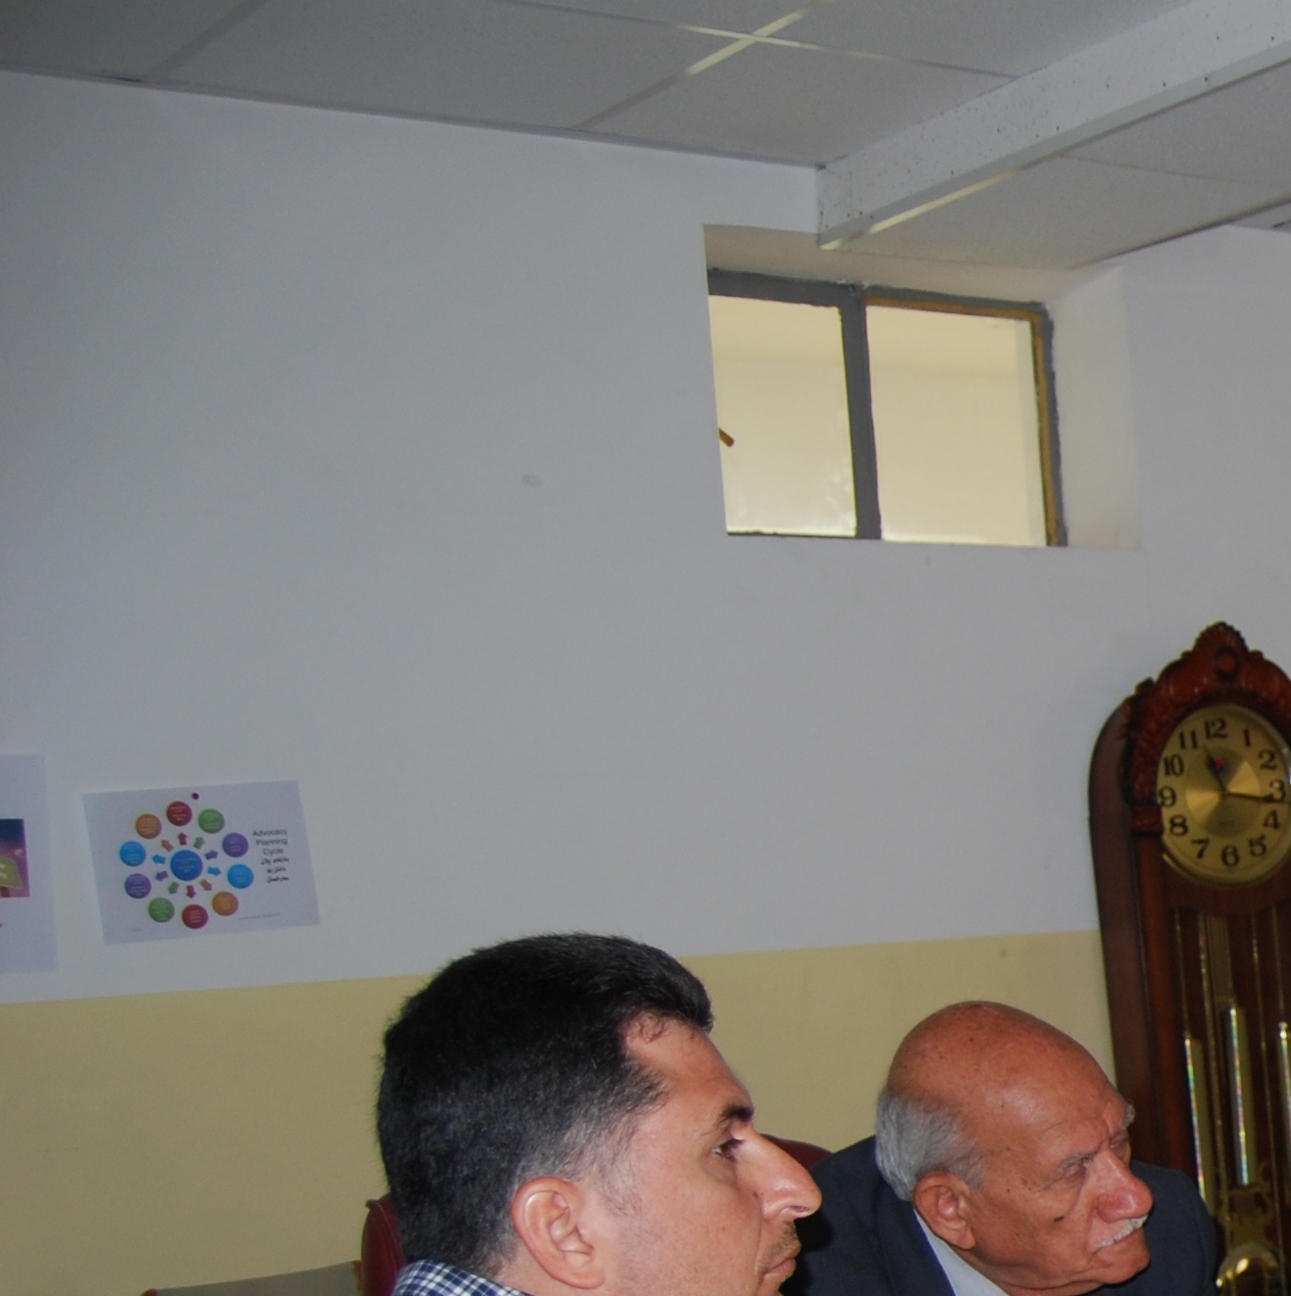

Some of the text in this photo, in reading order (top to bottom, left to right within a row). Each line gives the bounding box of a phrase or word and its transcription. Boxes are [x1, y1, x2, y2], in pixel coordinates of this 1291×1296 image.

[1204, 717, 1228, 739] 12
[1243, 728, 1253, 748] 1
[1178, 729, 1199, 750] 11
[1162, 755, 1184, 776] 10
[1258, 750, 1279, 770] 2
[1158, 786, 1177, 807] 9
[1169, 815, 1189, 836] 8
[1263, 810, 1281, 830] 4
[1191, 837, 1210, 859] 7
[1221, 845, 1241, 867] 6
[1248, 834, 1267, 857] 5
